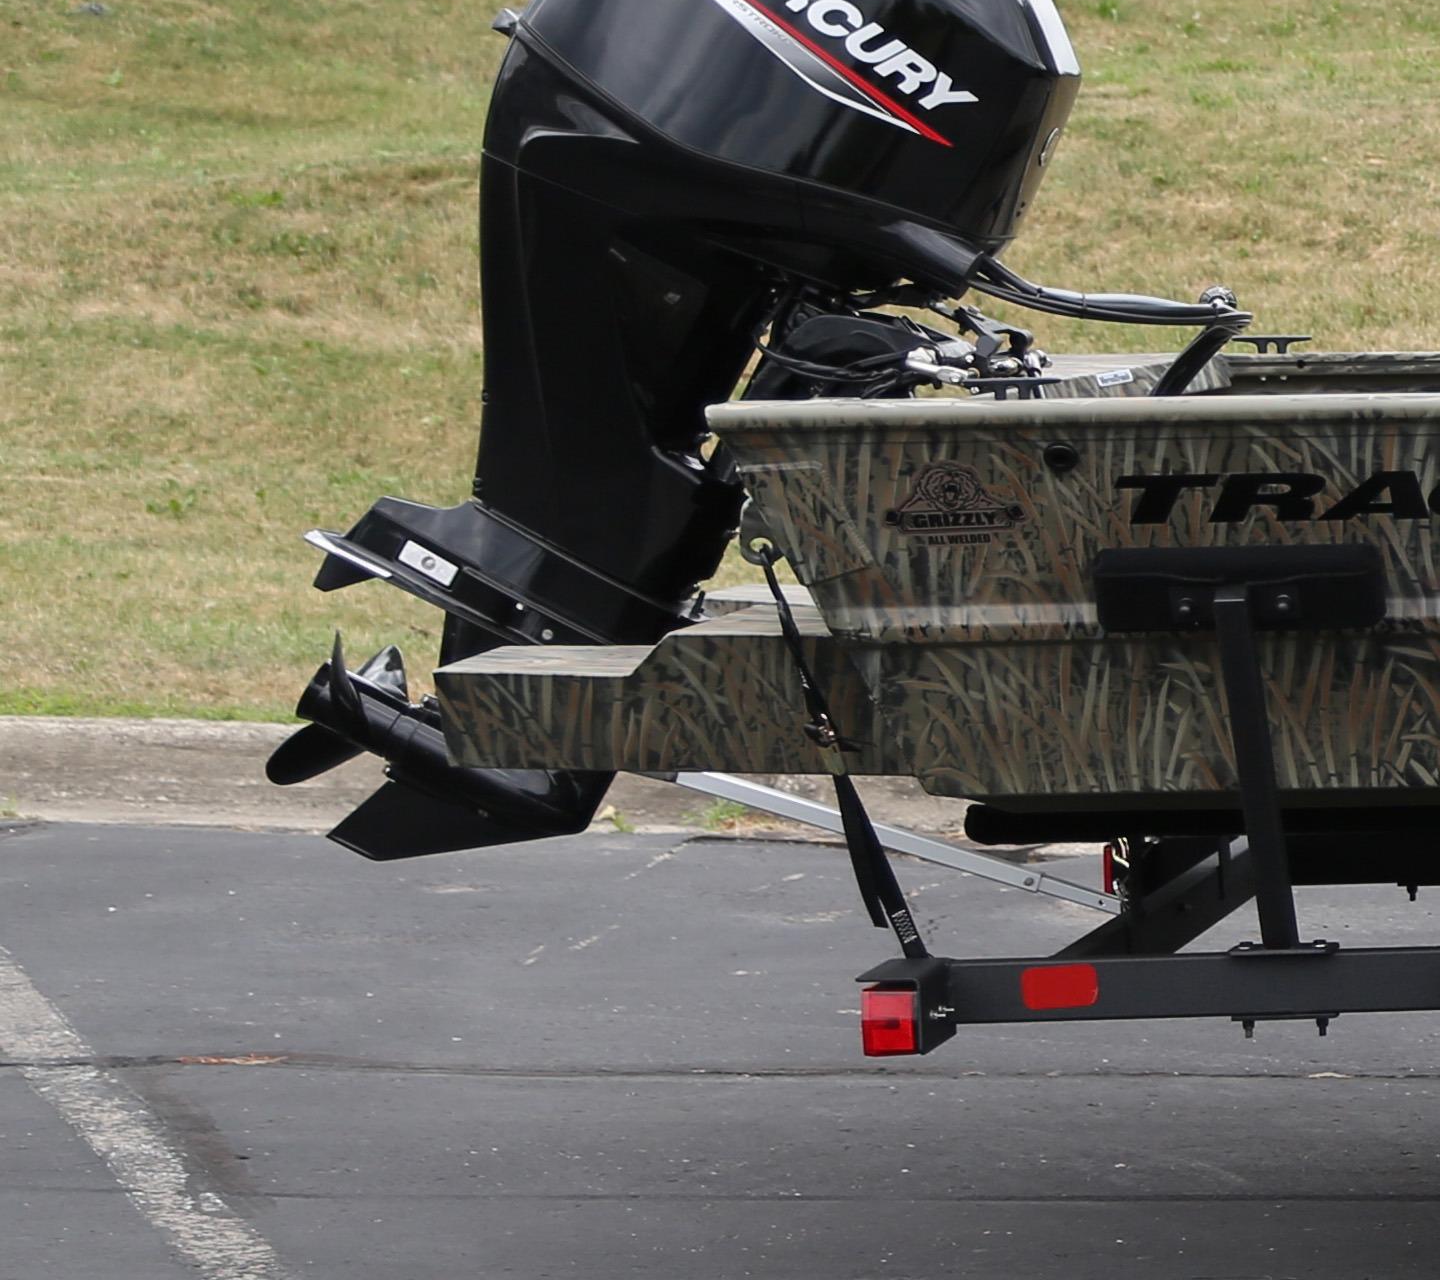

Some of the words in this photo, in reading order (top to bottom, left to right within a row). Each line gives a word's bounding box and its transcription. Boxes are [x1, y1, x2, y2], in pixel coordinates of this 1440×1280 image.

[911, 512, 996, 529] GRIZZLY
[928, 534, 946, 545] ALL
[950, 533, 991, 544] WELDED
